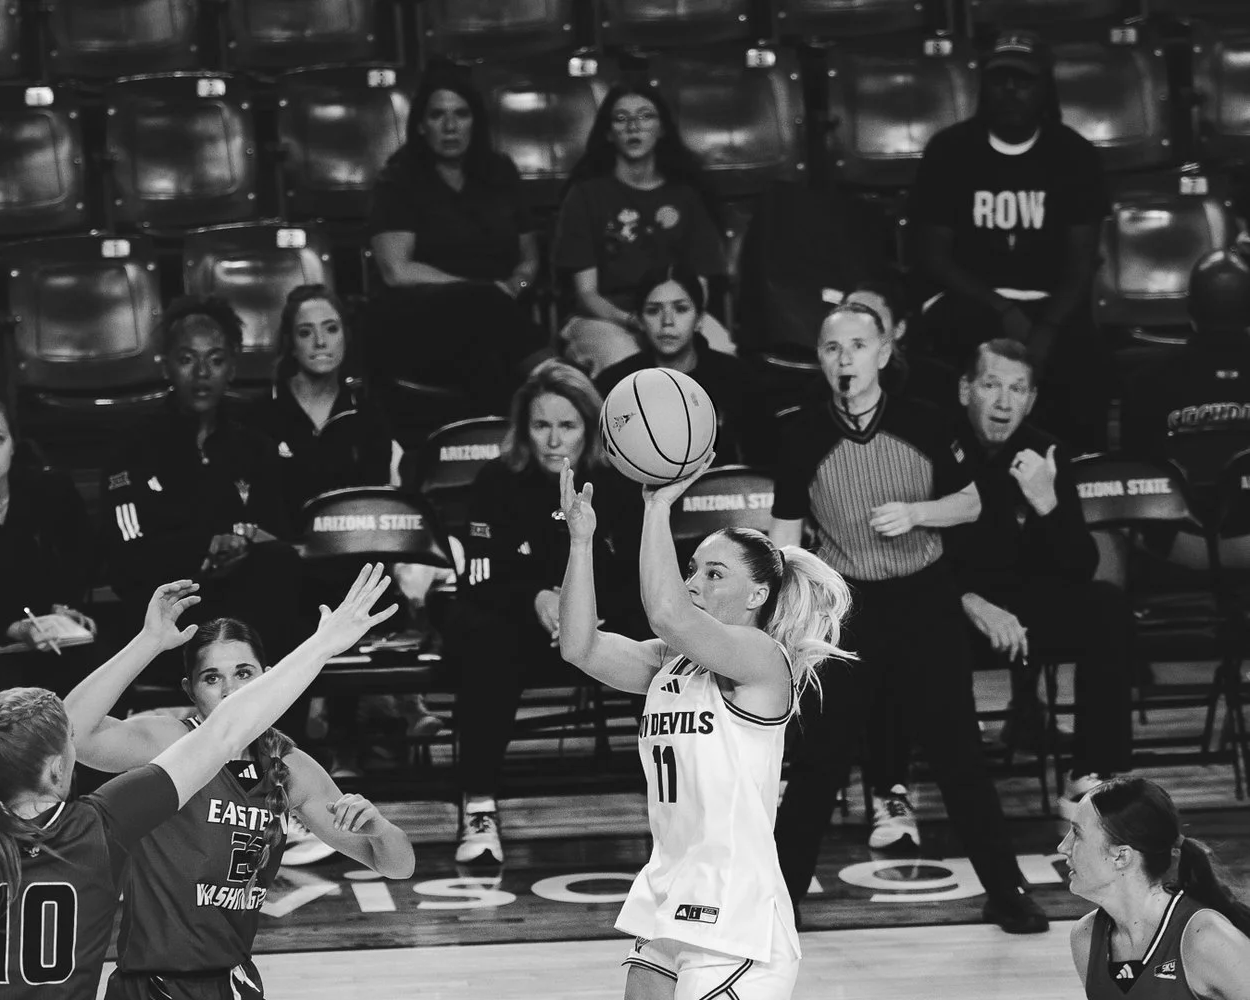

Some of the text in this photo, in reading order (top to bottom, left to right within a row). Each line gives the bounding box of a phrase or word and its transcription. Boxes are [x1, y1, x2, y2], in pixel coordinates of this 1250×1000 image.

[973, 190, 1046, 229] ROW
[1127, 477, 1172, 495] STATE
[313, 514, 423, 531] ARIZONA STATE
[650, 711, 715, 736] DEVILS
[652, 744, 678, 803] 11
[207, 798, 288, 836] EASTE
